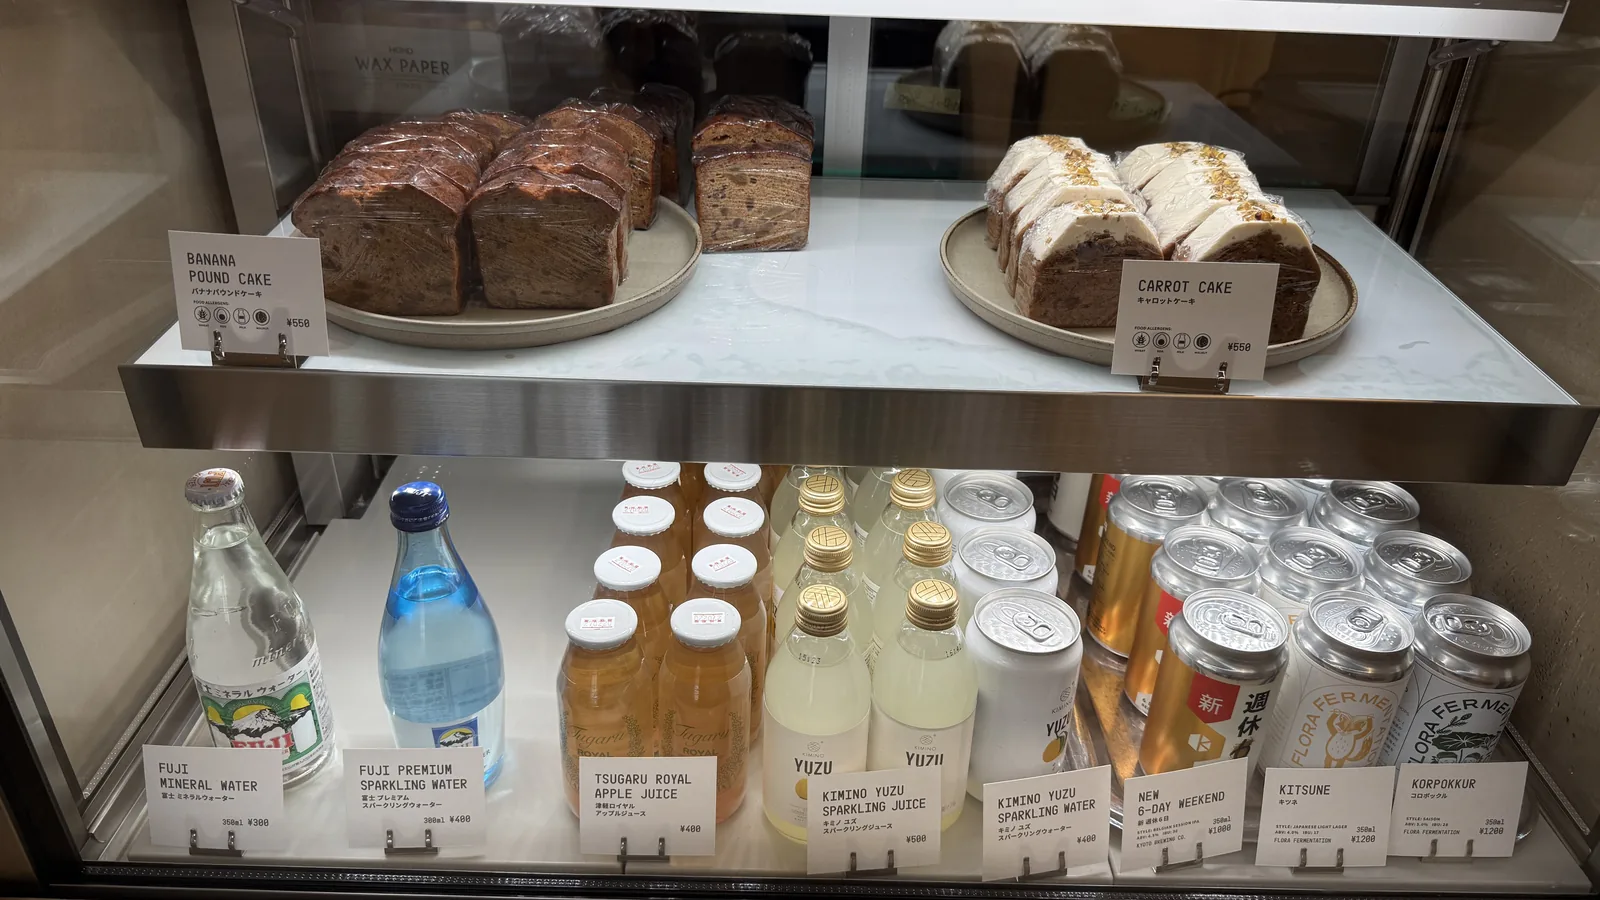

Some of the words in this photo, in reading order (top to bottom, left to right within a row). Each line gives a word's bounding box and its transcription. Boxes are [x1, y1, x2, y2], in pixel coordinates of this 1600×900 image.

[355, 56, 393, 72] WAX
[400, 59, 449, 76] PAPER
[187, 252, 236, 267] BANANA
[189, 270, 230, 284] POUND
[238, 272, 272, 286] CAKE
[1138, 279, 1190, 293] CARROT
[1198, 281, 1233, 294] CAKE
[191, 288, 262, 298] バナナパウンドケーキ
[1137, 297, 1196, 305] キャロットケーキ
[286, 318, 310, 328] ¥550
[1227, 342, 1251, 352] ¥550
[1198, 693, 1223, 715] 新
[1291, 713, 1320, 767] FLORA
[577, 748, 614, 758] ROYAL
[682, 747, 719, 756] ROYAL
[158, 762, 189, 775] FUJI
[360, 765, 390, 776] FUJI
[398, 764, 452, 776] PREMIUM
[794, 757, 833, 776] YUZU
[160, 777, 213, 791] MINERAL
[221, 780, 258, 792] WATER
[360, 780, 426, 791] SPARKLING
[432, 779, 468, 790] WATER
[595, 774, 648, 785] TSUGARU
[656, 774, 692, 785] ROYAL
[1412, 778, 1477, 789] KORPOKKUR
[595, 788, 633, 799] APPLE
[640, 788, 678, 799] JUICE
[822, 788, 867, 802] KIMINO
[876, 785, 904, 798] YUZU
[1280, 785, 1331, 795] KITSUNE
[162, 792, 175, 800] 富士
[177, 793, 235, 802] ミネラルウォーター
[998, 793, 1041, 810] KIMINO
[1049, 788, 1076, 802] YUZU
[1138, 790, 1160, 802] NEW
[595, 802, 636, 810] 津軽ロイヤル
[822, 802, 886, 816] SPARKLING
[892, 798, 926, 812] JUICE
[1138, 801, 1171, 816] 6-DAY
[1179, 791, 1225, 809] WEEKEND
[998, 805, 1059, 824] SPARKLING
[1063, 799, 1096, 814] WATER
[248, 818, 269, 827] ¥300
[449, 815, 471, 823] ¥400
[680, 824, 701, 833] ¥400
[824, 824, 893, 834] スパークリングジュース
[998, 826, 1016, 834] キミノ
[998, 826, 1072, 841] スパークリングウォーター
[1208, 824, 1231, 834] ¥1000
[1479, 827, 1504, 835] ¥1200
[1077, 834, 1096, 844] ¥400
[1351, 835, 1376, 843] ¥1200
